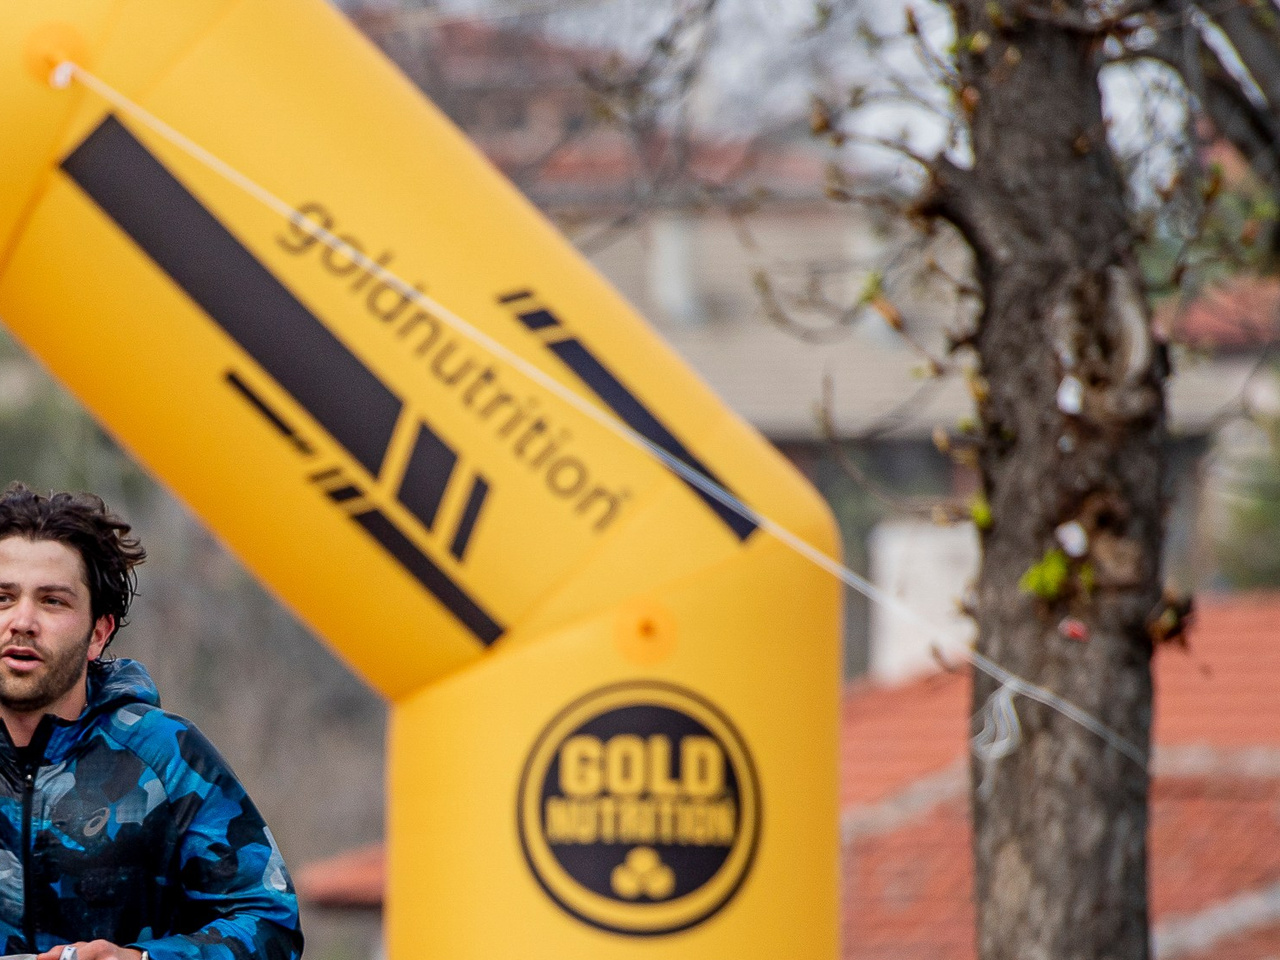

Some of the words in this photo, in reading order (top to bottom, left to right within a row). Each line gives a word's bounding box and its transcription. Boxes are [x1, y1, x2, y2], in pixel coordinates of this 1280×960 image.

[273, 200, 624, 532] goldnutrition
[558, 733, 726, 797] GOLD
[546, 795, 737, 846] NUTRITION
